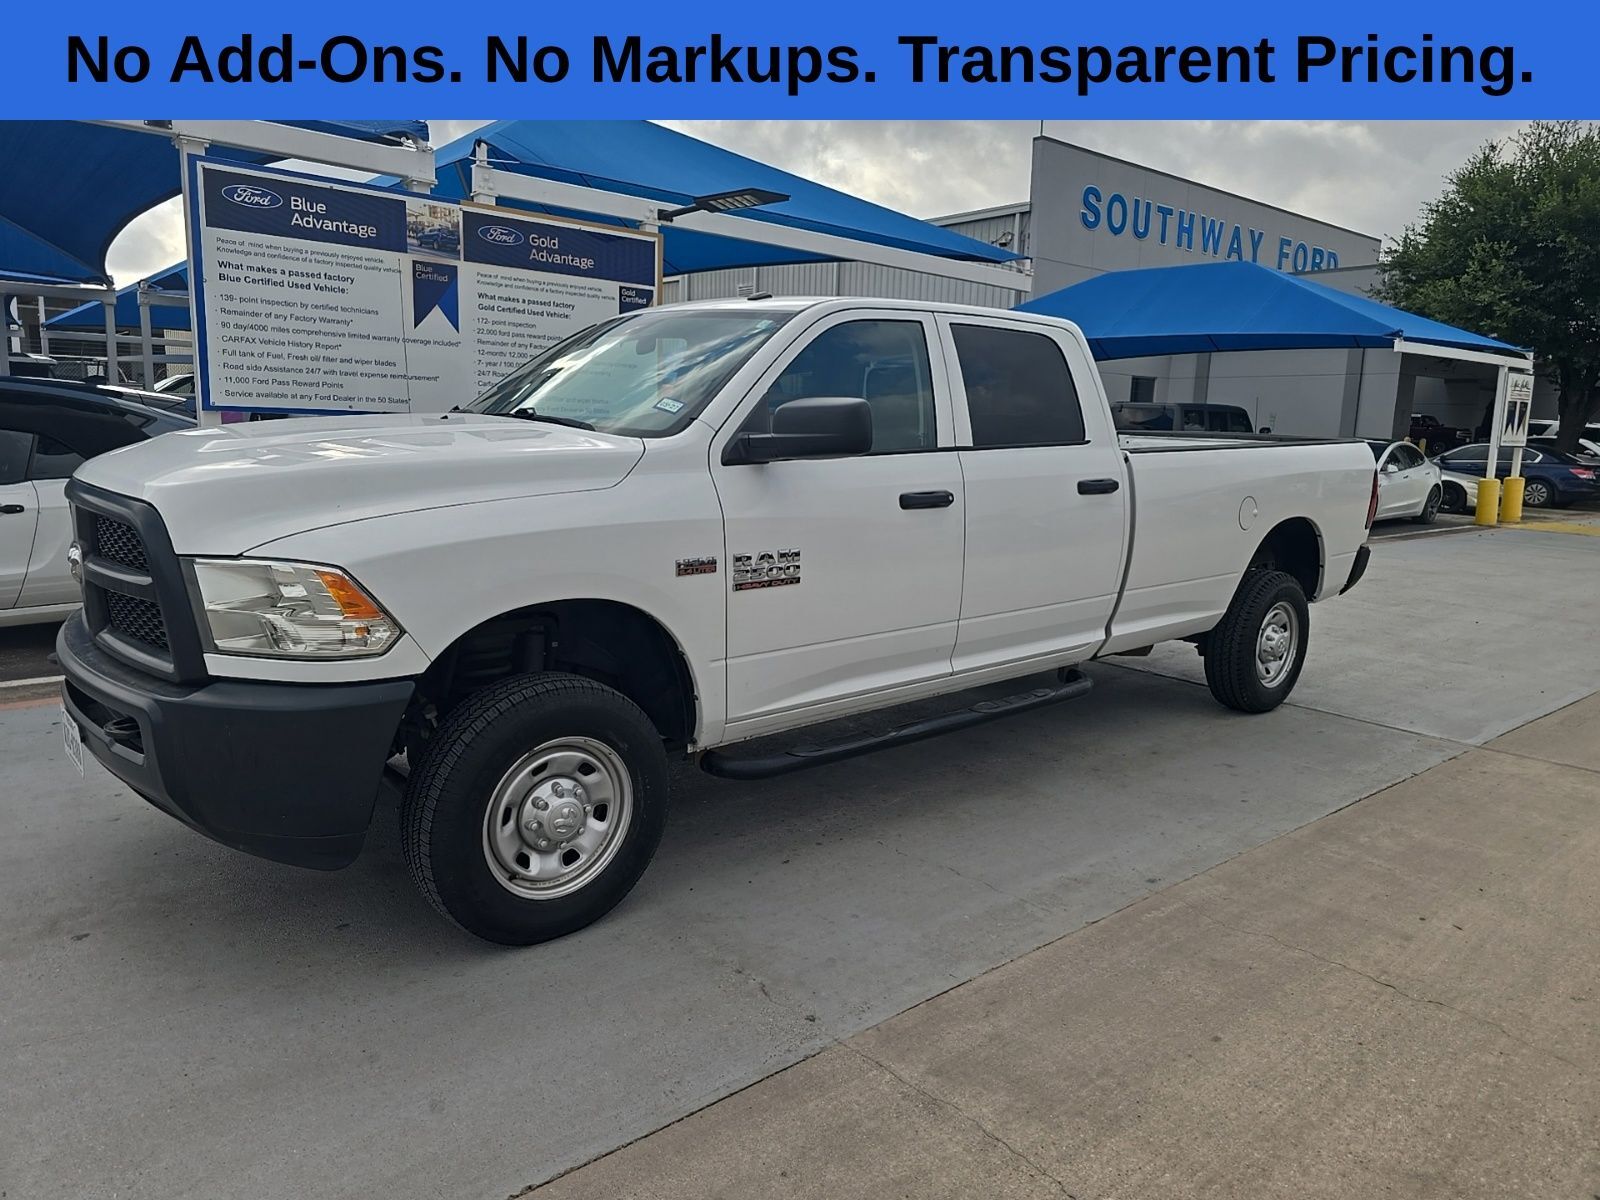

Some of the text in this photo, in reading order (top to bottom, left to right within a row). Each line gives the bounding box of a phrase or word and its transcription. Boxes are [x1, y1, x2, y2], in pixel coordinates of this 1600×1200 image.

[233, 187, 272, 206] Ford
[290, 196, 327, 214] Blue
[290, 213, 377, 238] Advantage
[1080, 185, 1339, 273] SOUTHWAY FORD
[487, 227, 516, 244] Ford
[529, 234, 559, 249] Gold
[216, 237, 237, 245] Peace
[265, 243, 282, 251] when
[283, 246, 303, 254] buying
[310, 250, 340, 259] previously
[341, 253, 363, 262] enjoyed
[216, 246, 252, 257] Knowledge
[267, 252, 300, 262] confidence
[314, 258, 334, 267] factory
[335, 261, 363, 270] inspected
[364, 264, 382, 273] quality
[529, 248, 595, 269] Advantage
[217, 260, 244, 270] What
[246, 264, 278, 274] makes
[288, 270, 322, 280] passed
[324, 272, 355, 285] factory
[416, 264, 433, 273] Blue
[416, 272, 448, 282] Certified
[218, 272, 349, 294] Blue Certified Used Vehicle:
[476, 280, 504, 288] Knowledge
[527, 278, 542, 286] buying
[622, 288, 636, 296] Gold
[622, 296, 646, 304] Certified
[239, 296, 258, 304] point
[260, 298, 298, 308] inspection
[300, 302, 309, 310] by
[310, 304, 339, 312] certified
[340, 306, 379, 316] technicians
[477, 292, 496, 301] What
[497, 295, 520, 304] makes
[527, 299, 552, 307] passed
[552, 301, 576, 310] factory
[220, 308, 262, 318] Remainder
[274, 313, 288, 322] any
[289, 314, 317, 324] Factory
[478, 303, 572, 320] Gold Certified Used Vehicle:
[508, 321, 536, 329] inspection
[221, 335, 257, 344] CARFAX
[258, 338, 286, 347] Vehicle
[287, 340, 314, 350] History
[232, 322, 269, 332] day/4000
[270, 326, 290, 334] miles
[292, 328, 347, 338] comprehensive
[348, 332, 370, 340] limited
[372, 334, 400, 344] warranty
[402, 337, 432, 346] coverage
[476, 338, 509, 347] Remainder
[546, 334, 564, 342] points
[222, 348, 236, 357] Full
[238, 350, 256, 358] tank
[266, 352, 286, 360] Fuel,
[287, 353, 308, 361] Fresh
[374, 359, 397, 368] blades
[223, 362, 244, 370] Road
[246, 364, 262, 372] side
[263, 365, 304, 374] Assistance
[322, 368, 338, 376] with
[224, 376, 250, 384] 11,000
[272, 378, 290, 386] Pass
[292, 380, 320, 388] Reward
[322, 381, 344, 390] Points
[224, 390, 254, 398] Service
[255, 391, 289, 400] available
[290, 392, 298, 400] at
[299, 394, 313, 402] any
[332, 394, 356, 402] Dealer
[377, 396, 387, 404] 50
[733, 549, 800, 568] RAM
[733, 563, 800, 582] 2500
[736, 578, 799, 590] HEAVY DUTY
